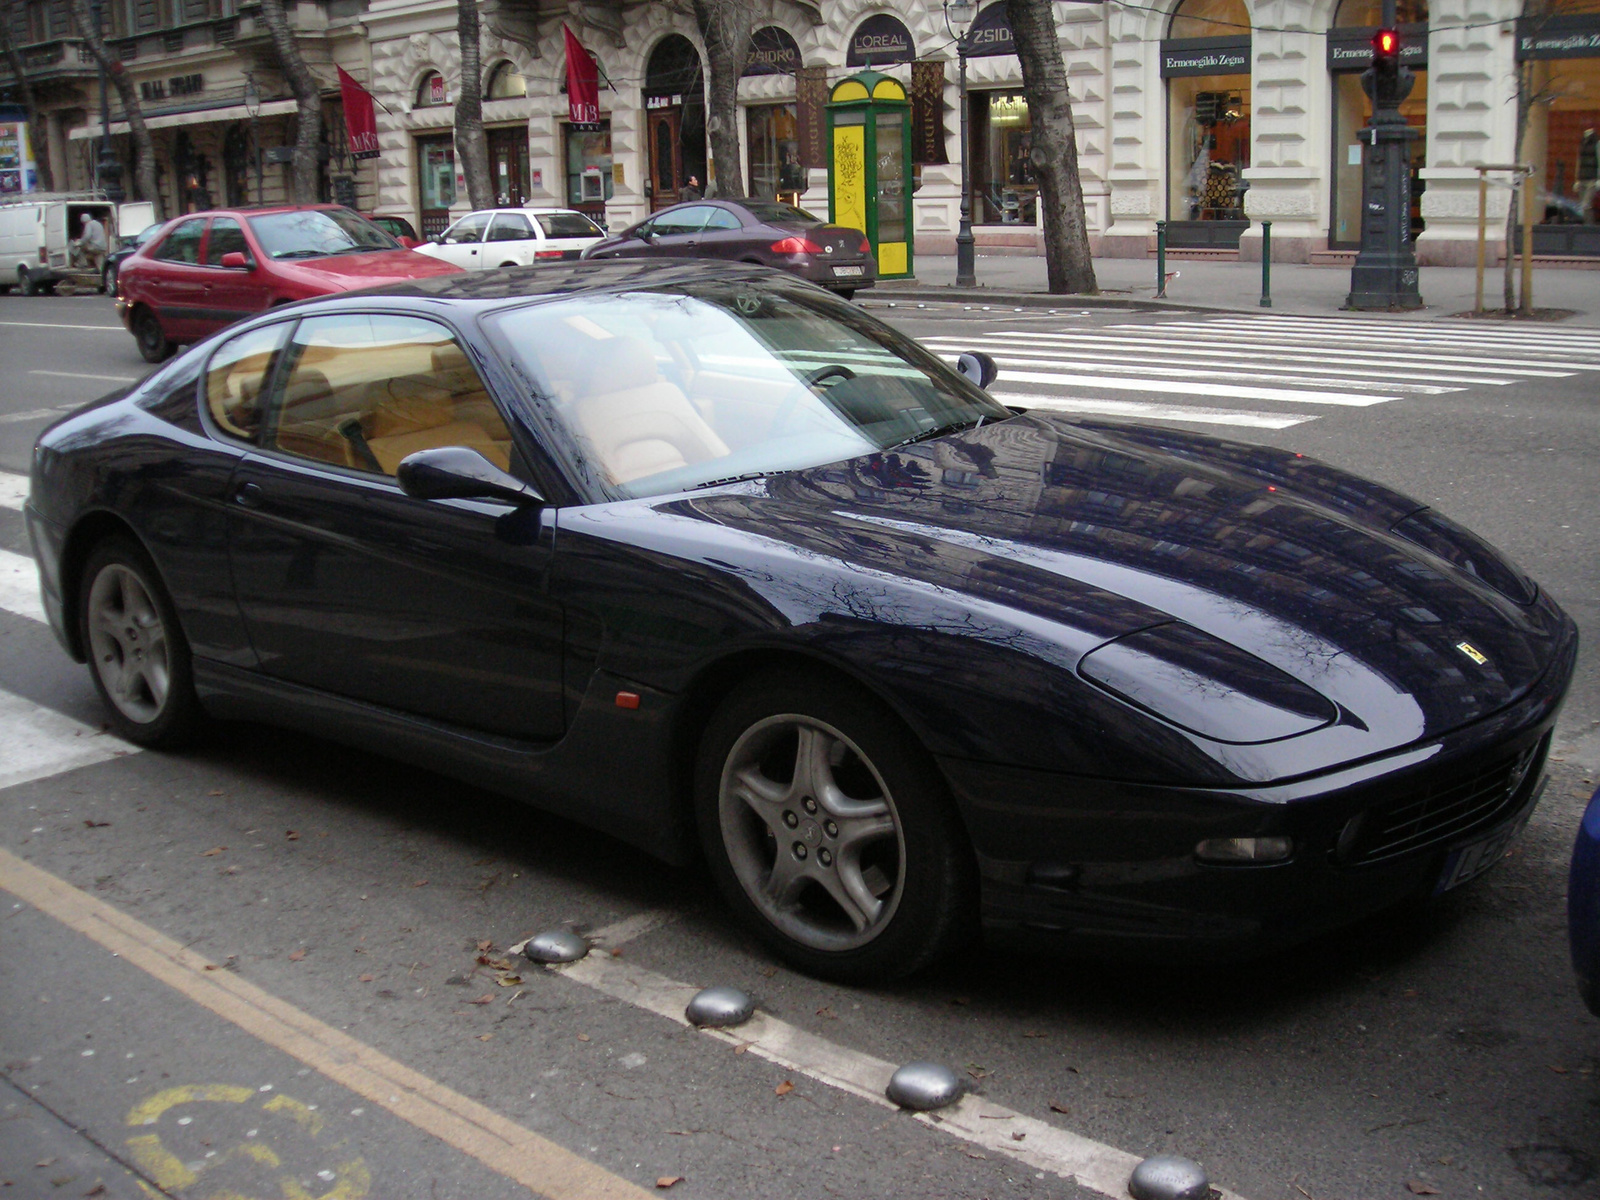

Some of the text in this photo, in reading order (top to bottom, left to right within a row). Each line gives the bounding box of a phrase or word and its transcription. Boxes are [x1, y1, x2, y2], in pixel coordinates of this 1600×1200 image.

[973, 27, 1013, 44] ZSID
[1521, 34, 1590, 51] Emenegildo
[1333, 46, 1422, 59] Ermeneg egna
[1166, 54, 1245, 68] Ermenegildo Zegna
